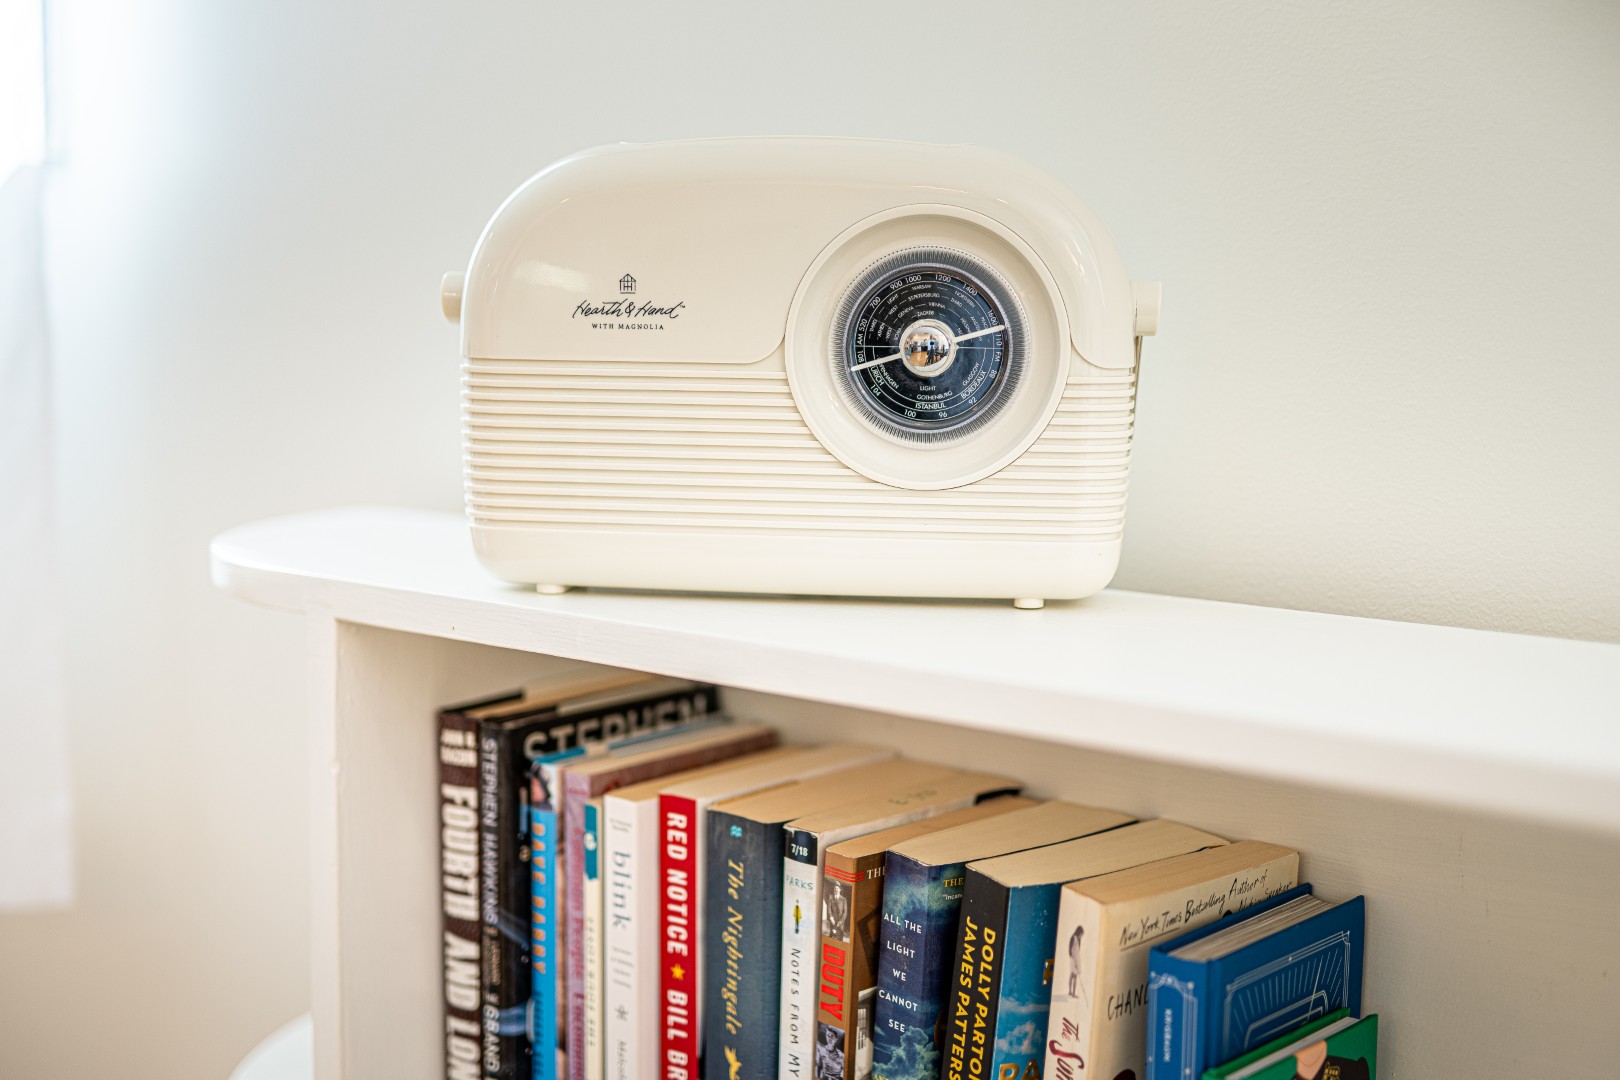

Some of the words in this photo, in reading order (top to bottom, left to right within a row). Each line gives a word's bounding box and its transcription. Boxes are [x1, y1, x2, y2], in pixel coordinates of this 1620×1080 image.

[890, 280, 903, 291] 900
[904, 275, 922, 284] 1000
[935, 274, 952, 283] 1200
[963, 283, 980, 298] 1400
[572, 298, 628, 318] Hearth
[624, 301, 636, 318] &
[870, 296, 881, 309] 700
[897, 305, 914, 319] GENEVA
[955, 291, 978, 310] NORTHERN
[859, 318, 868, 332] 520
[986, 310, 999, 326] 1600
[857, 333, 864, 345] AM
[870, 384, 882, 397] 104
[904, 409, 917, 418] 100
[939, 411, 948, 419] 96
[968, 397, 978, 406] 92
[989, 370, 998, 380] 88
[995, 352, 1002, 362] FM
[915, 402, 947, 410] ISTANBUL
[961, 370, 987, 400] BORDEAUX
[962, 362, 981, 387] GLASGOW
[481, 737, 498, 826] STEPHEN
[442, 783, 480, 921] FOURTH
[667, 812, 688, 861] RED
[791, 843, 808, 857] 7/18
[532, 822, 546, 886] DAVE
[482, 833, 499, 924] HAWKING
[612, 850, 632, 930] blink
[728, 859, 745, 900] The
[943, 878, 964, 888] THE
[667, 869, 688, 956] NOTICE
[883, 913, 901, 926] ALL
[904, 920, 922, 934] THE
[1119, 921, 1138, 946] New
[1140, 915, 1161, 940] York
[1161, 910, 1182, 932] Times
[1184, 893, 1226, 924] Bestselling
[1228, 877, 1259, 900] Author
[1259, 868, 1268, 888] of
[532, 895, 547, 974] BARRY
[887, 940, 916, 959] LIGHT
[958, 915, 979, 989] JAMES
[978, 926, 996, 1001] DOLLY
[444, 931, 481, 1011] AND
[722, 906, 745, 1035] Nightingale
[790, 948, 801, 999] NOTES
[820, 943, 846, 1021] DUTY
[892, 968, 907, 982] WE
[666, 991, 688, 1040] BILL
[878, 989, 918, 1012] CANNOT
[483, 1004, 500, 1071] GRAND
[789, 1004, 801, 1045] FROM
[888, 1018, 906, 1033] SEE
[1062, 1015, 1080, 1043] The
[788, 1052, 801, 1079] MY
